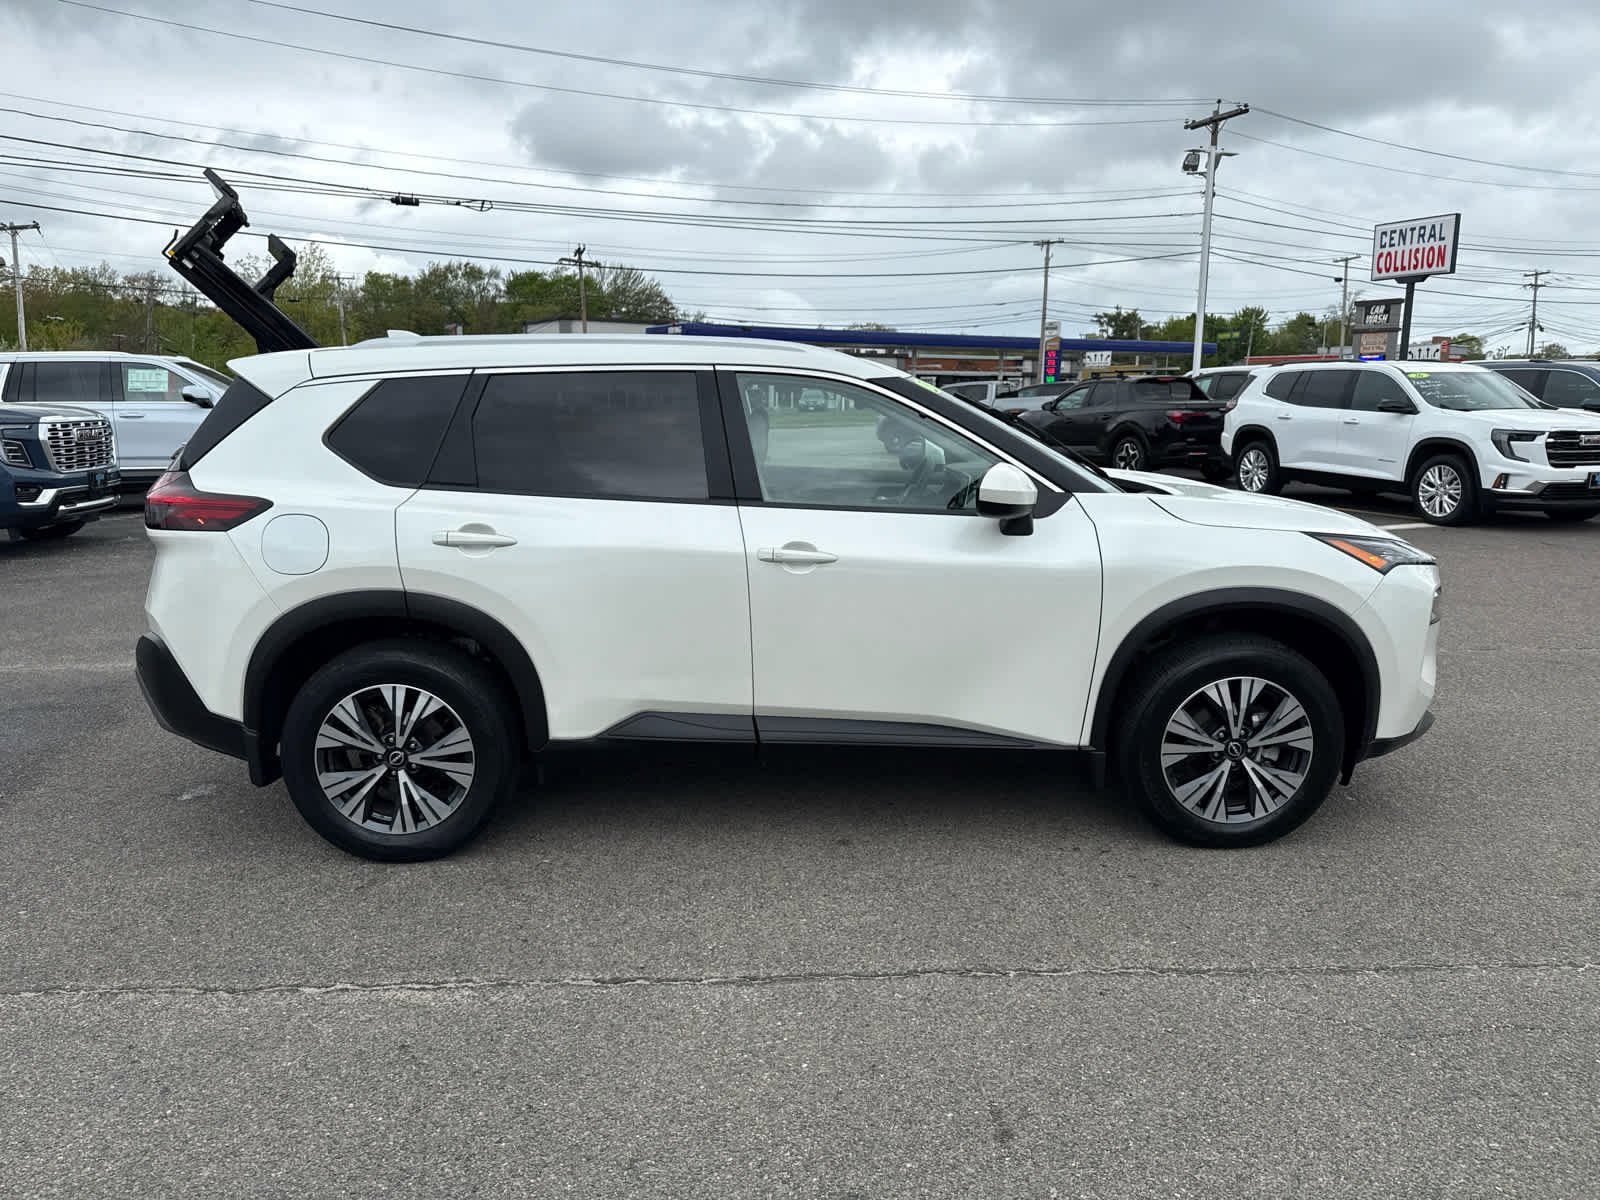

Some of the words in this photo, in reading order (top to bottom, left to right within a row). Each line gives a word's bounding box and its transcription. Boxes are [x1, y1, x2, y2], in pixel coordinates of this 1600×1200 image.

[1380, 223, 1446, 249] CENTRAL
[1376, 244, 1447, 274] COLLISION
[1365, 313, 1389, 324] WASH
[1370, 304, 1386, 315] CAR
